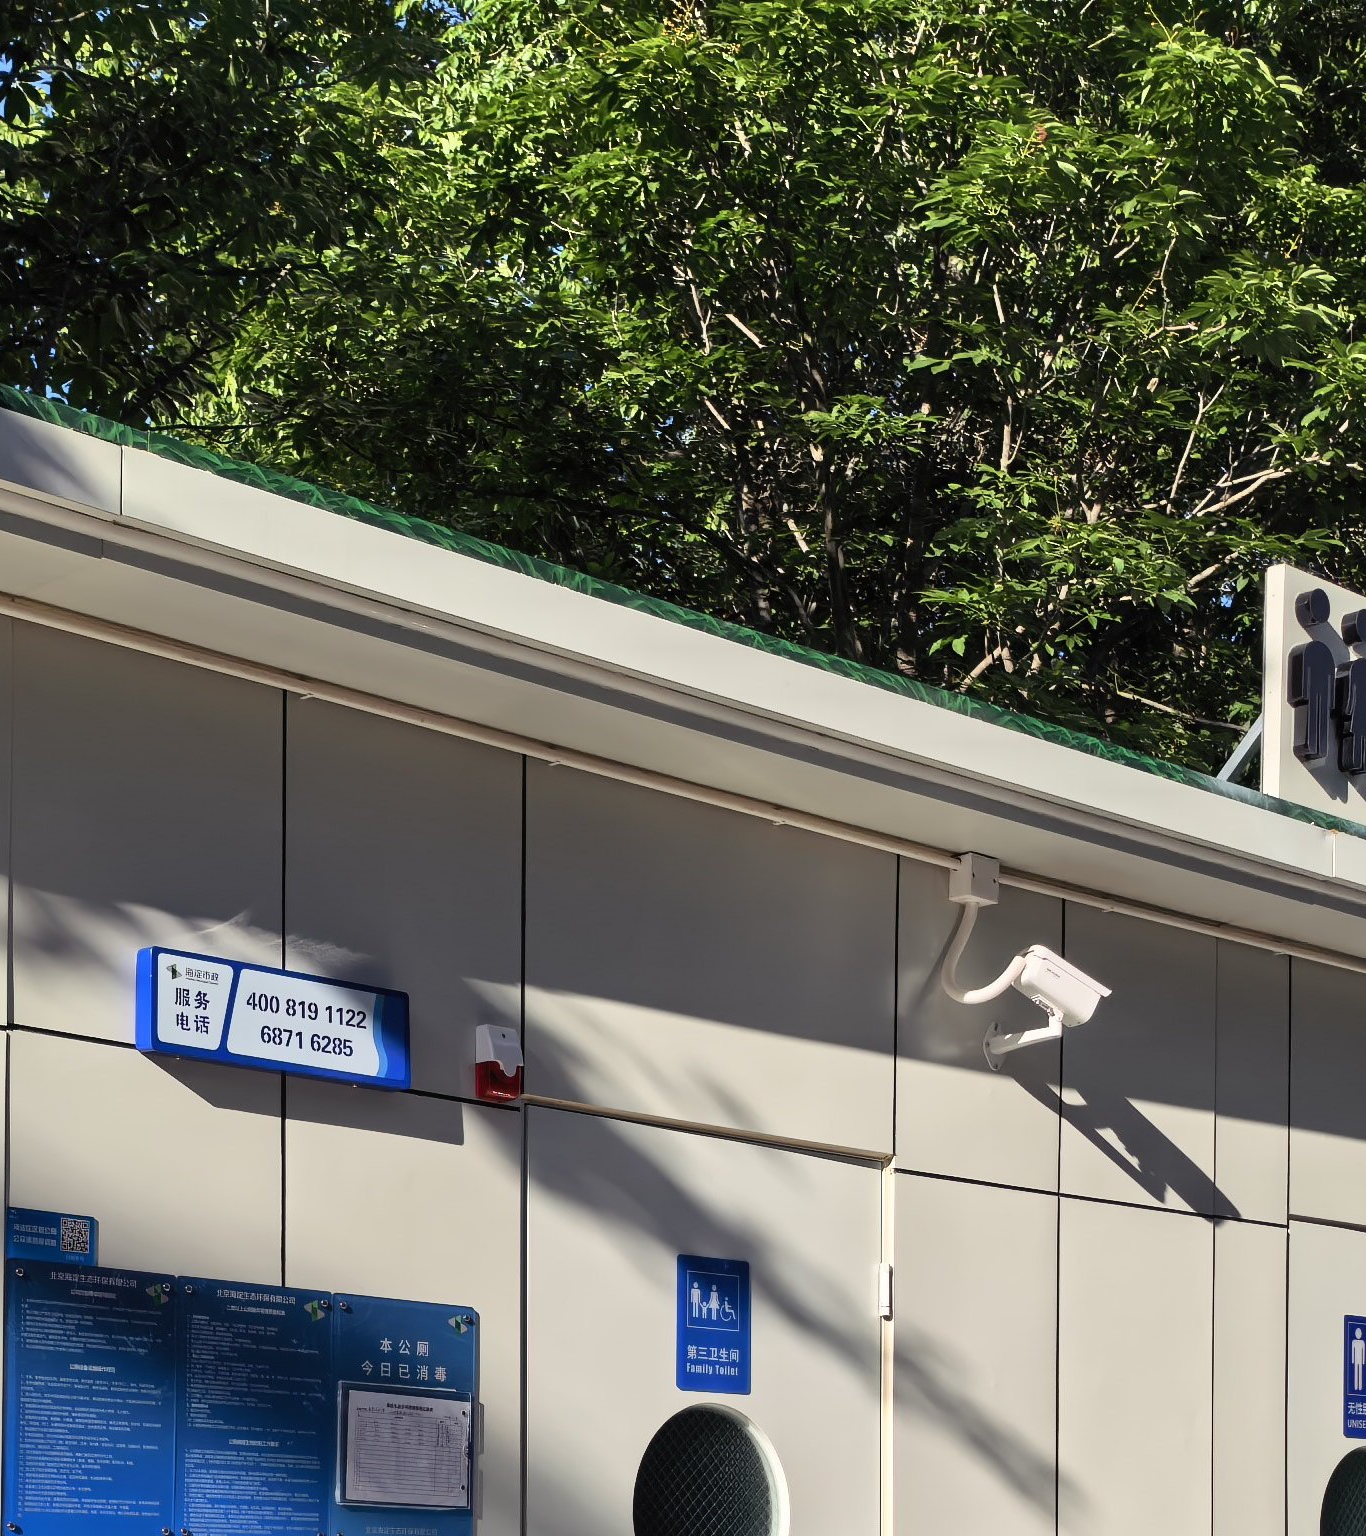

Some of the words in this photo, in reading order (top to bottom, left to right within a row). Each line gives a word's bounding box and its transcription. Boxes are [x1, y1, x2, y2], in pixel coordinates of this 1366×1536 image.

[175, 987, 210, 1010] 服务
[246, 991, 280, 1015] 400
[285, 998, 318, 1021] 819
[325, 1005, 367, 1030] 1122
[176, 1011, 210, 1034] 电话
[260, 1025, 304, 1050] 6871
[310, 1032, 354, 1058] 6285
[380, 1337, 429, 1357] 本公厕
[687, 1344, 740, 1363] 第三卫生间
[361, 1360, 447, 1382] 今日已消毒
[686, 1363, 713, 1375] Family
[715, 1364, 739, 1376] Toilet
